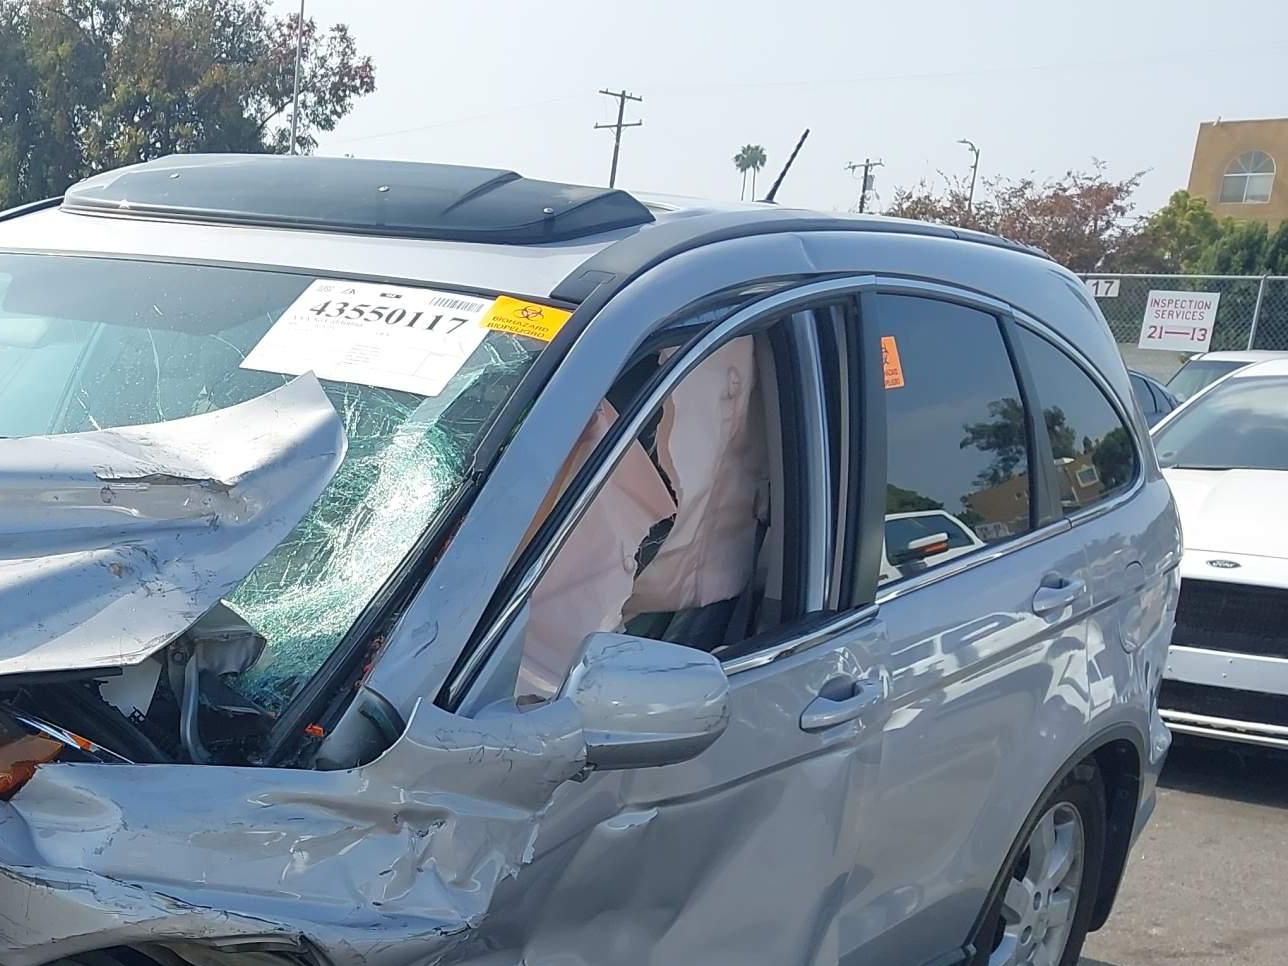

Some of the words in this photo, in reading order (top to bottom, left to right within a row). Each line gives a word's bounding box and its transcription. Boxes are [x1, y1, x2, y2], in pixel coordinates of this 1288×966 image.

[1091, 280, 1115, 296] 17
[1150, 298, 1212, 310] INSPECTION
[310, 300, 469, 334] 43550117
[1154, 309, 1205, 321] SERVICES
[487, 323, 545, 338] BIOPELIGRO
[492, 316, 550, 332] BIOHAZARD
